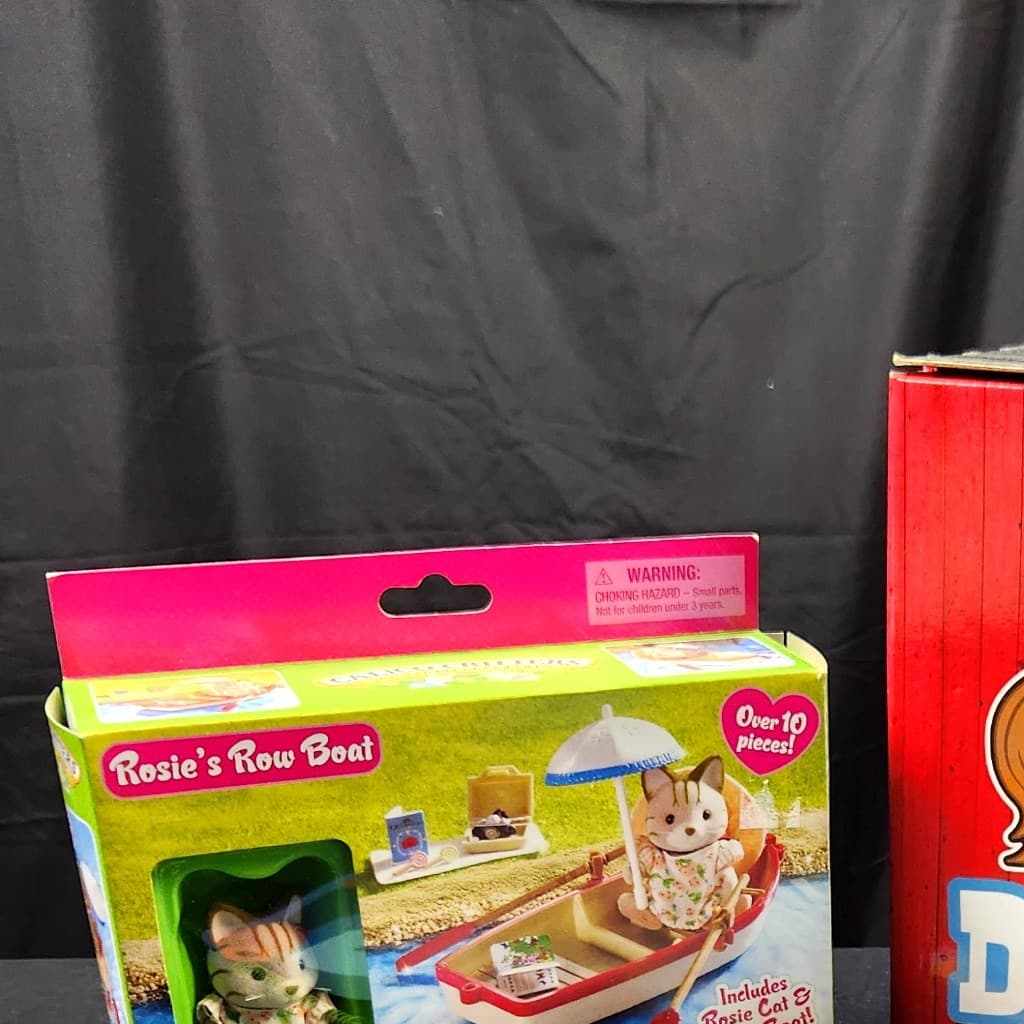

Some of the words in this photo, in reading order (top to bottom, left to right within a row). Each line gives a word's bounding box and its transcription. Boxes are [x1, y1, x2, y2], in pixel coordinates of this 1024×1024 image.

[627, 564, 701, 583] WARNING:
[595, 589, 640, 604] CHOKING
[641, 587, 681, 601] HAZARD
[692, 586, 717, 597] Small
[718, 586, 743, 598] parts.
[596, 605, 612, 617] Not
[613, 604, 625, 616] for
[627, 602, 663, 615] children
[664, 601, 690, 612] under
[692, 600, 698, 611] 3
[699, 601, 725, 612] years.
[735, 704, 780, 729] Over
[781, 710, 807, 736] 10
[735, 733, 794, 755] pieces!
[109, 747, 222, 786] Rosie's
[227, 739, 296, 775] Row
[300, 733, 375, 768] Boat
[720, 978, 789, 1006] Includes
[758, 996, 789, 1018] Cat
[793, 986, 812, 1007] &
